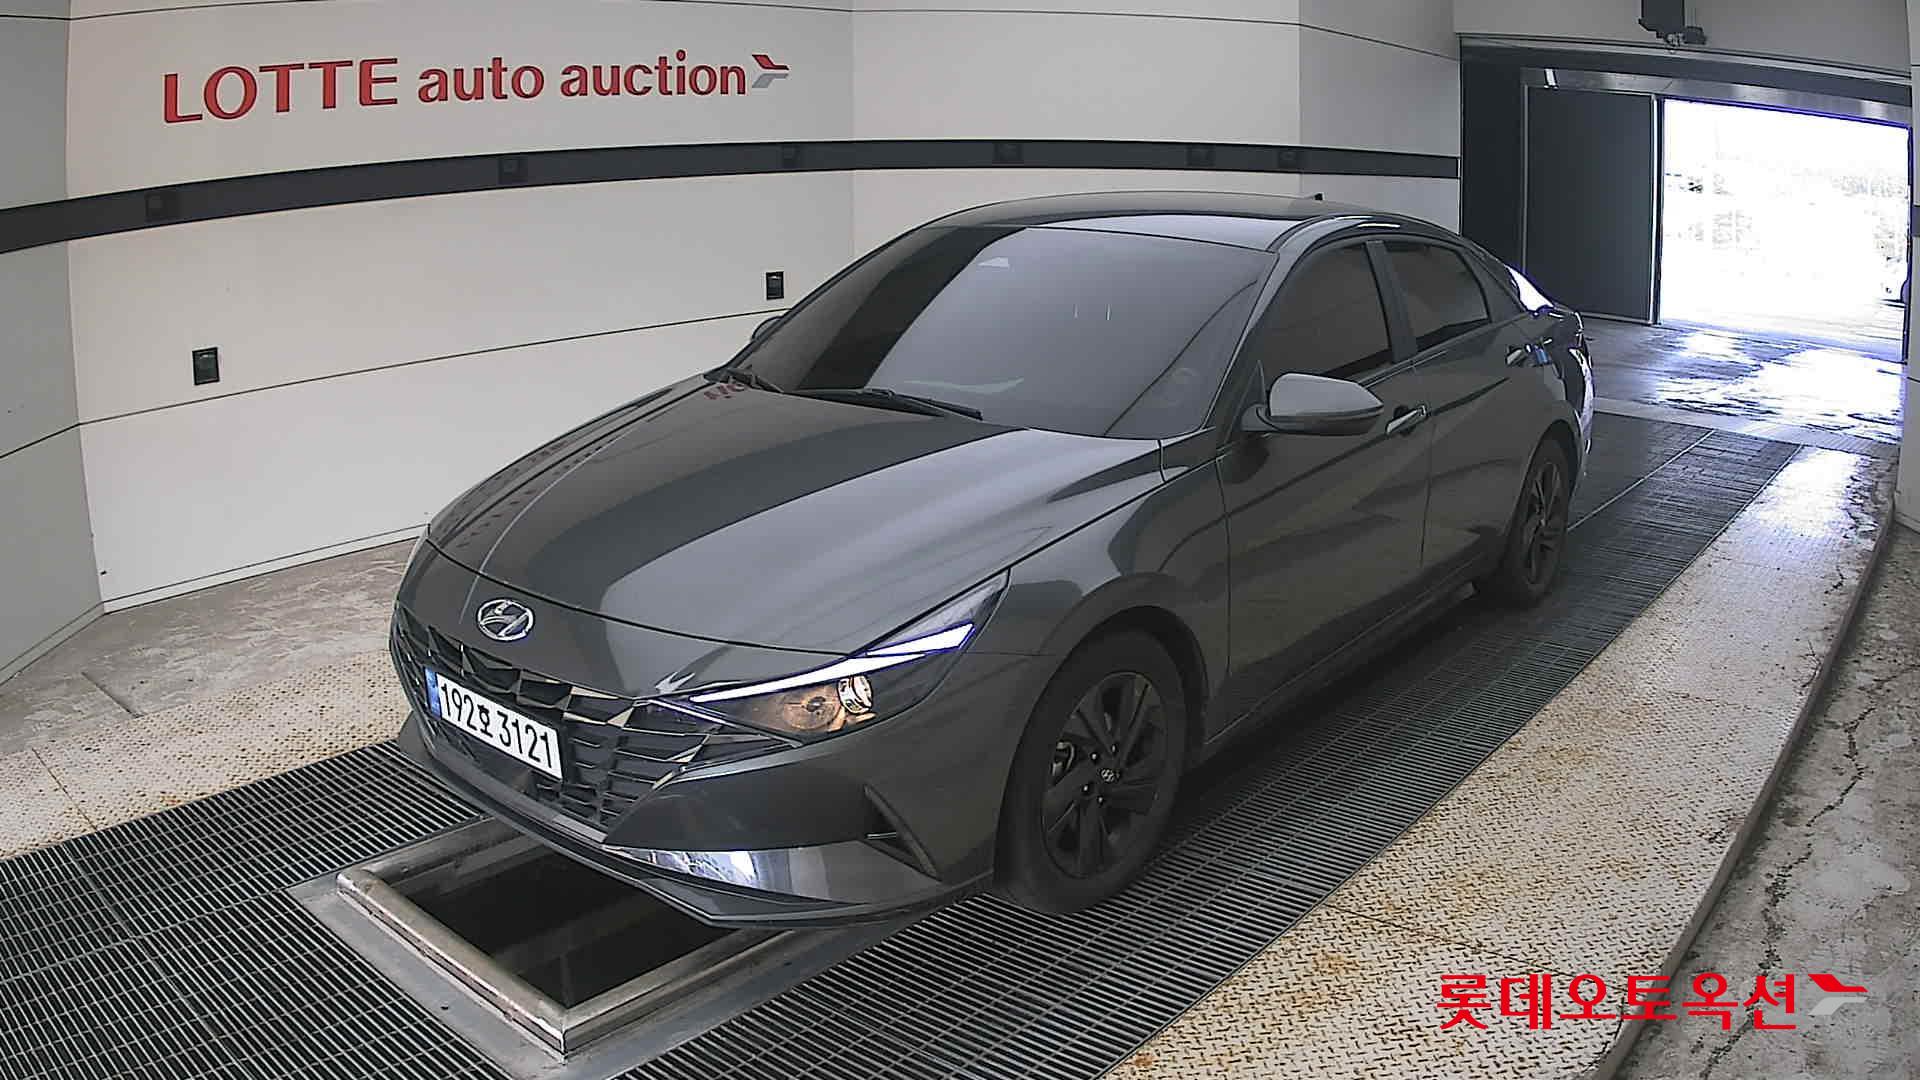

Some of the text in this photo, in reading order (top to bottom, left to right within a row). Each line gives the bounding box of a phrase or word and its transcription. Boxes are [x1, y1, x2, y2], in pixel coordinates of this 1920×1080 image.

[163, 49, 748, 124] LOTTE auto auction
[441, 683, 493, 738] 192호
[497, 710, 552, 769] 3121
